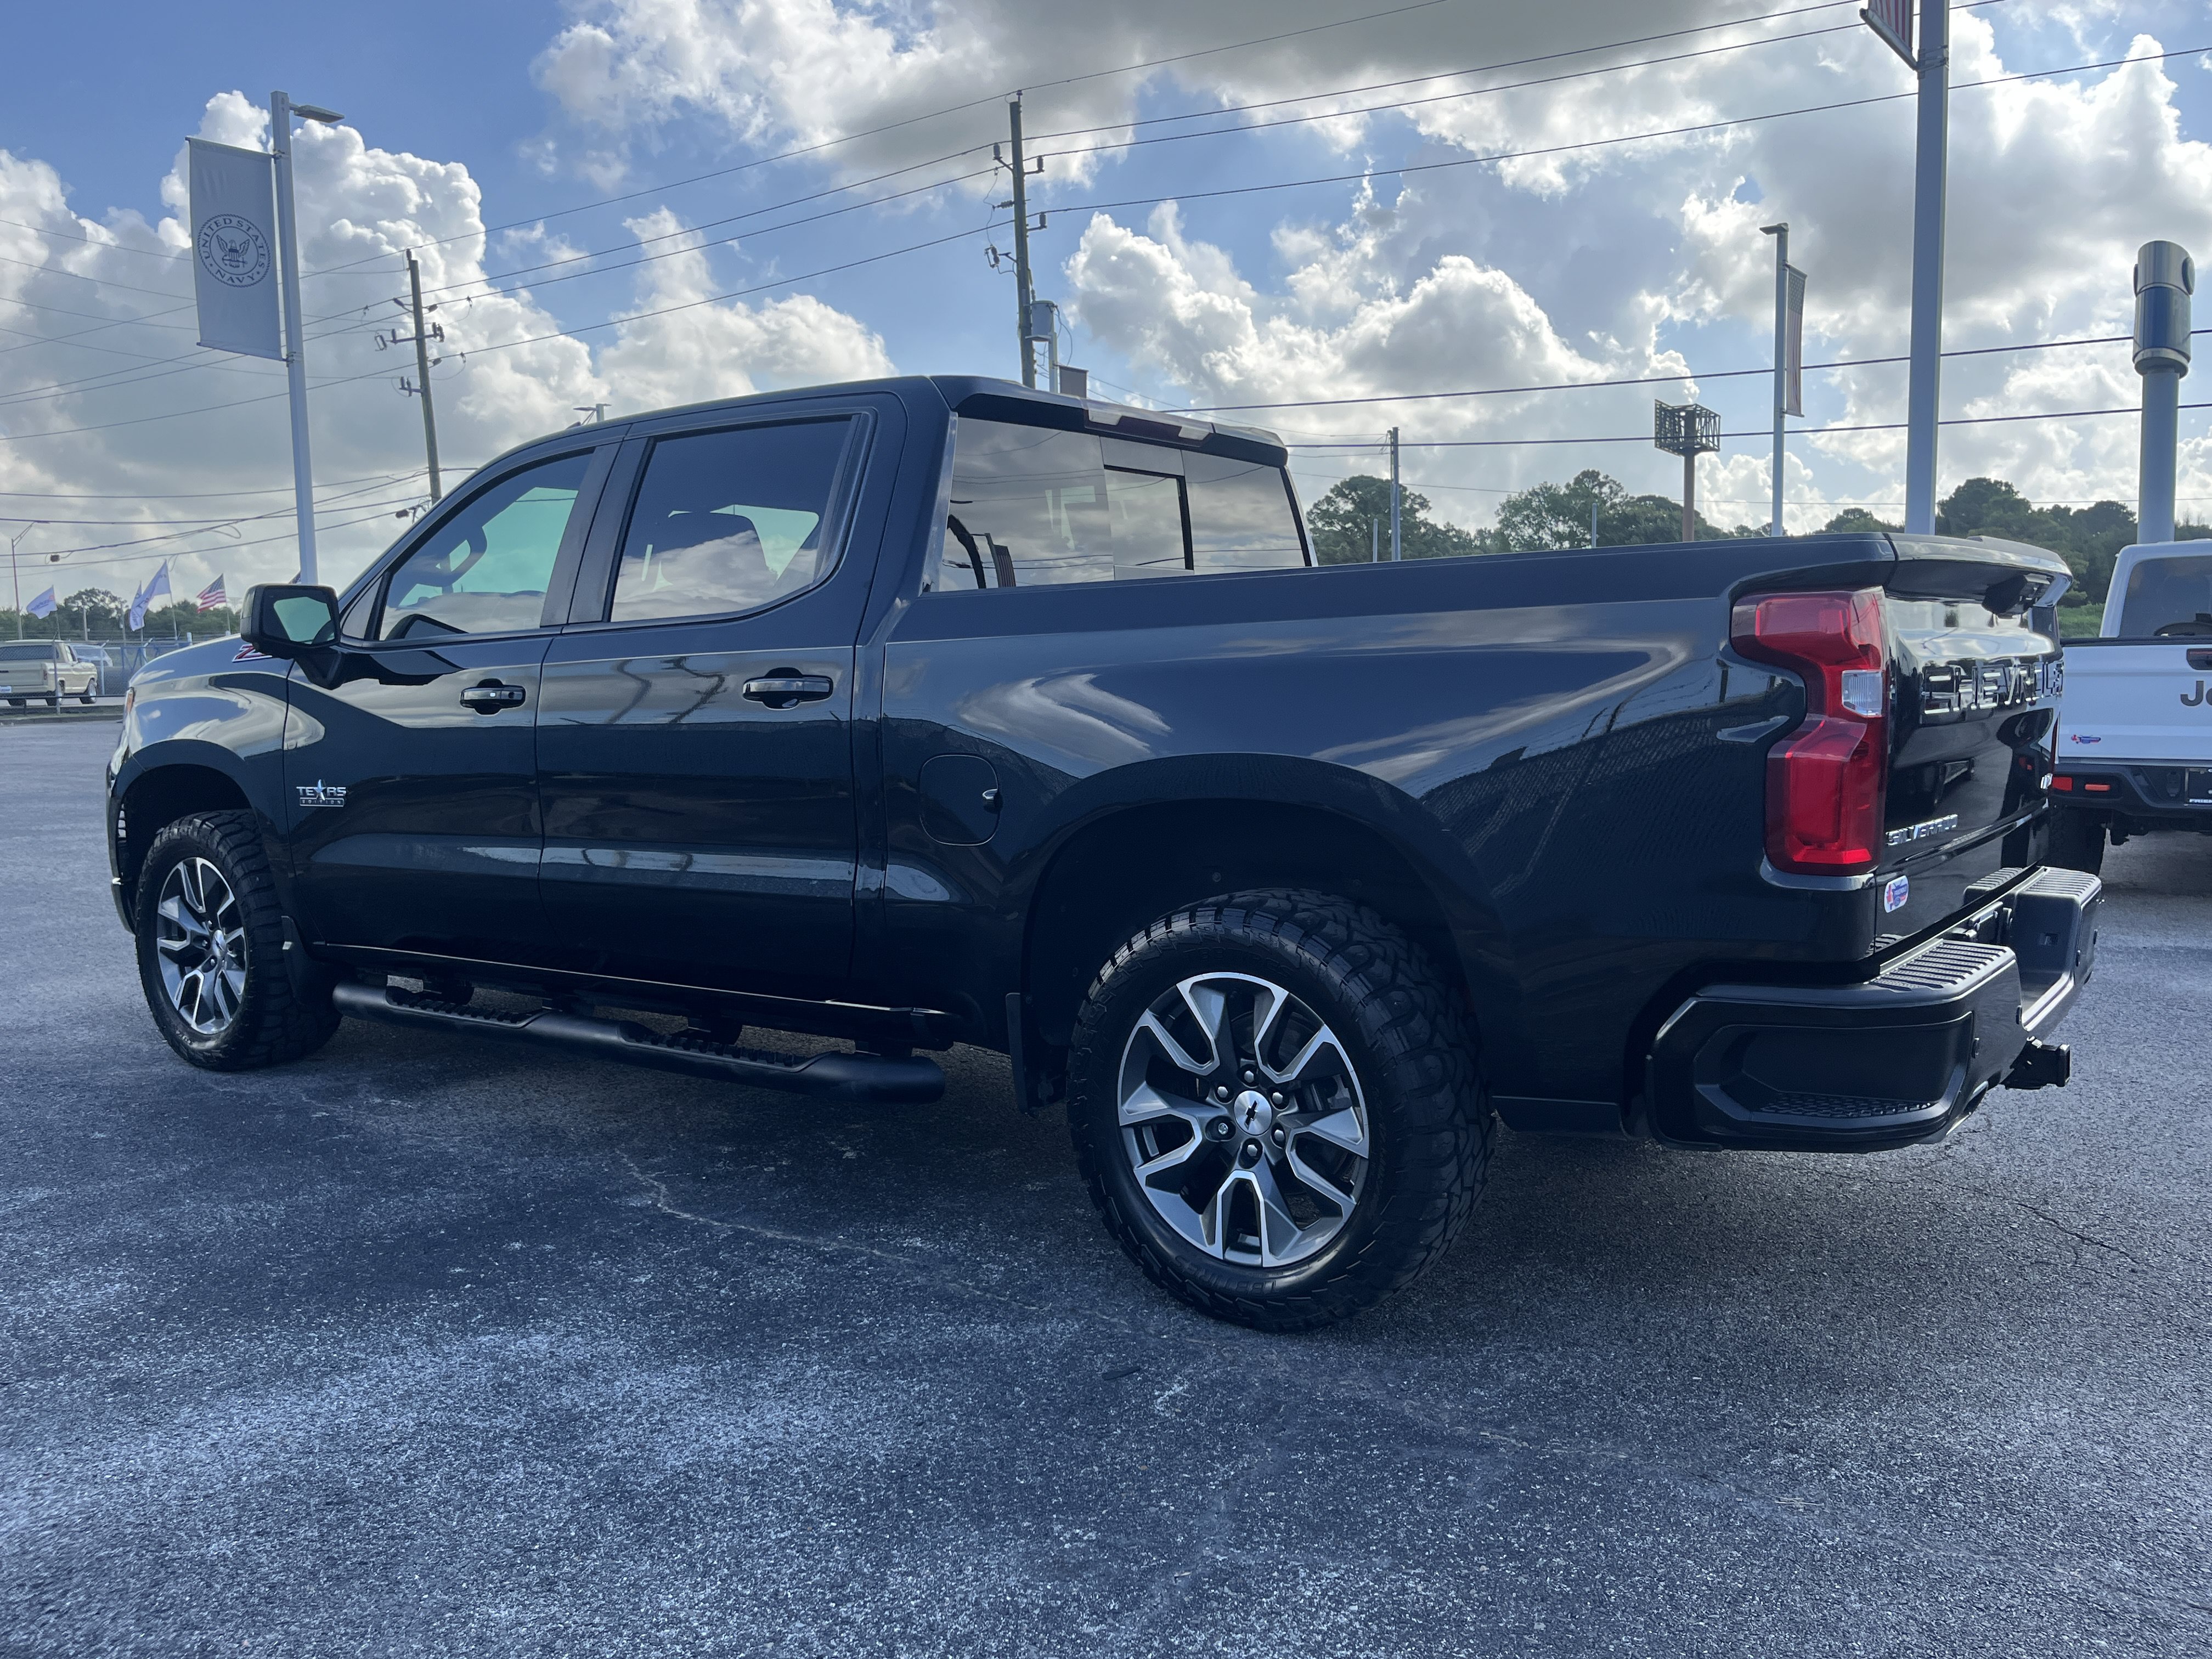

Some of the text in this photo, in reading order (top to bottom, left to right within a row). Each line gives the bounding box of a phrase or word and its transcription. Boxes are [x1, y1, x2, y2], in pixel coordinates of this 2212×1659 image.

[202, 218, 266, 268] UNITED STATES
[216, 269, 255, 284] NAVY
